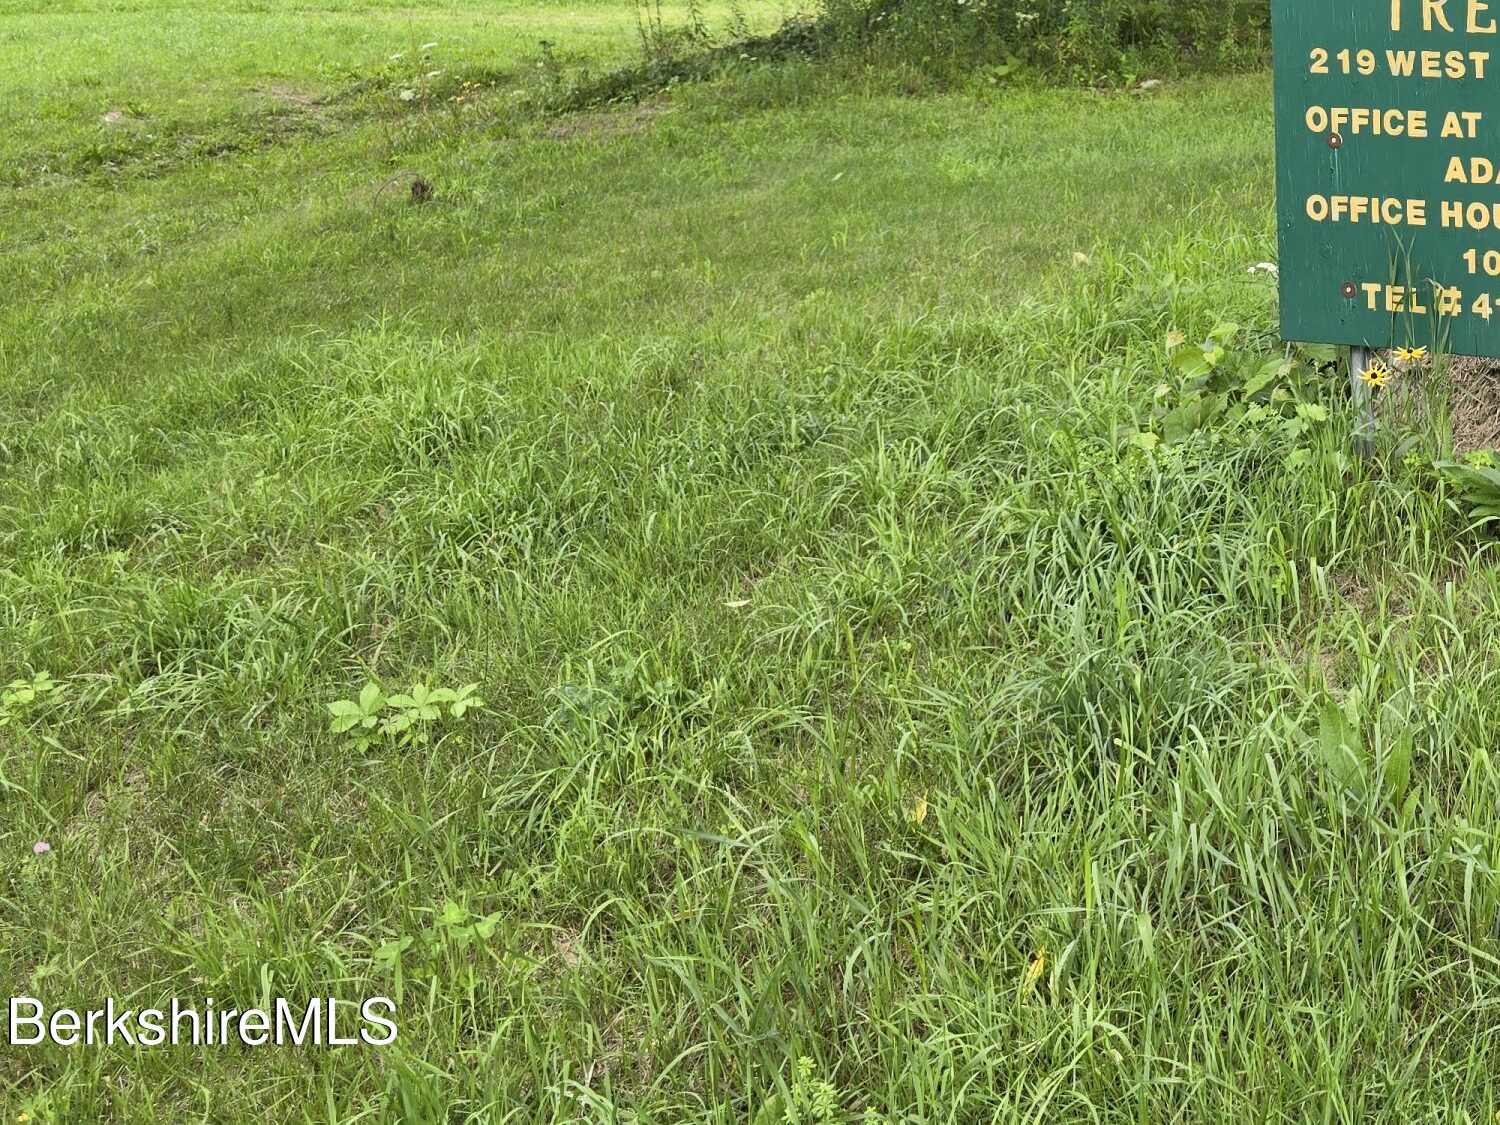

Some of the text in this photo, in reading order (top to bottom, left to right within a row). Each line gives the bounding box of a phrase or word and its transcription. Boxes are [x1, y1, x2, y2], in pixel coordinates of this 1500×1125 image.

[1310, 48, 1376, 75] 219
[1386, 50, 1489, 79] WEST
[1305, 105, 1426, 138] OFFICE
[1441, 111, 1481, 138] AT
[1305, 195, 1426, 225] OFFICE
